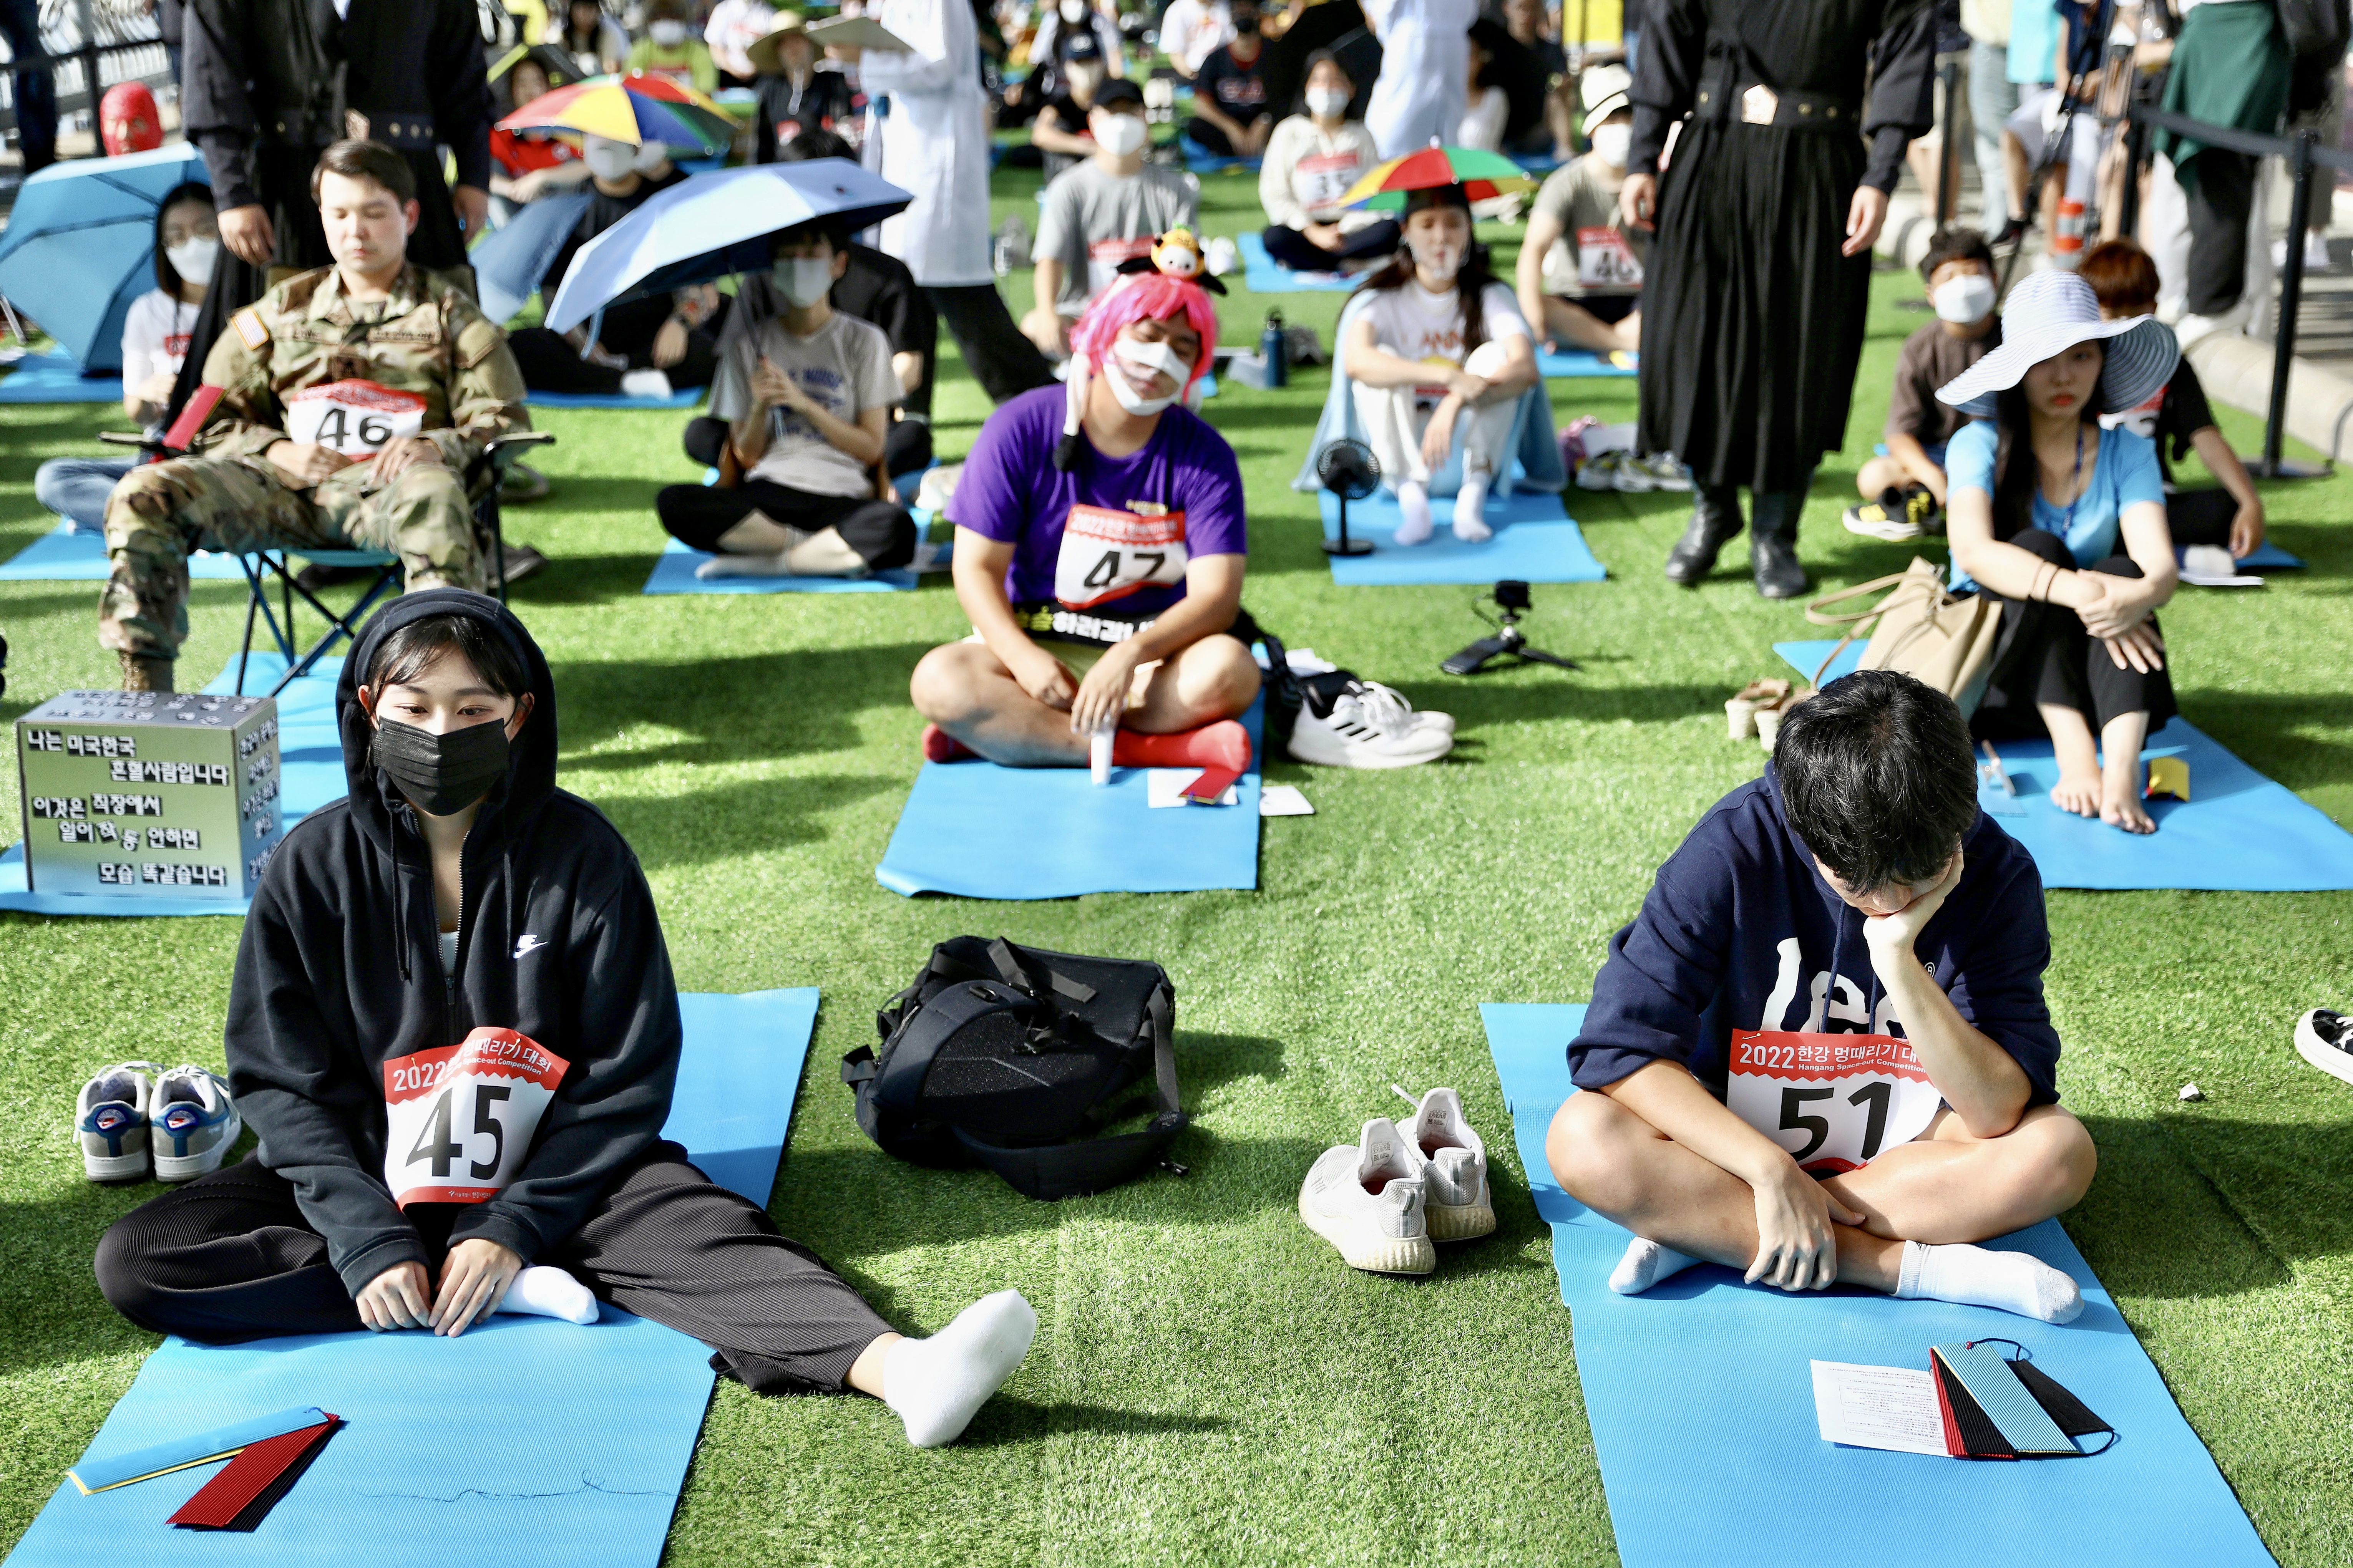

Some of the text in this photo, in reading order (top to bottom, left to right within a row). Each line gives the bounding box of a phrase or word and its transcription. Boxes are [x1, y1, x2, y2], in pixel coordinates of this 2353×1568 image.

[316, 408, 392, 447] 46
[1084, 551, 1165, 587] 47
[27, 729, 136, 758] 나는 미국한국
[111, 760, 229, 787] 혼혈사람입니다
[33, 792, 161, 819] 이것은 직장에서
[59, 820, 95, 844] 일이
[100, 862, 227, 887] 모습 똑같습니다
[393, 1060, 446, 1092] 2022
[462, 1037, 521, 1059] 멍때리기
[522, 1048, 552, 1072] 대회
[498, 1058, 542, 1075] Competition
[1739, 1043, 1920, 1069] 2022 한강 멍때리기 대
[1798, 1058, 1926, 1073] Hangang Space-out Competition
[405, 1084, 512, 1180] 45
[1778, 1081, 1892, 1163] 51
